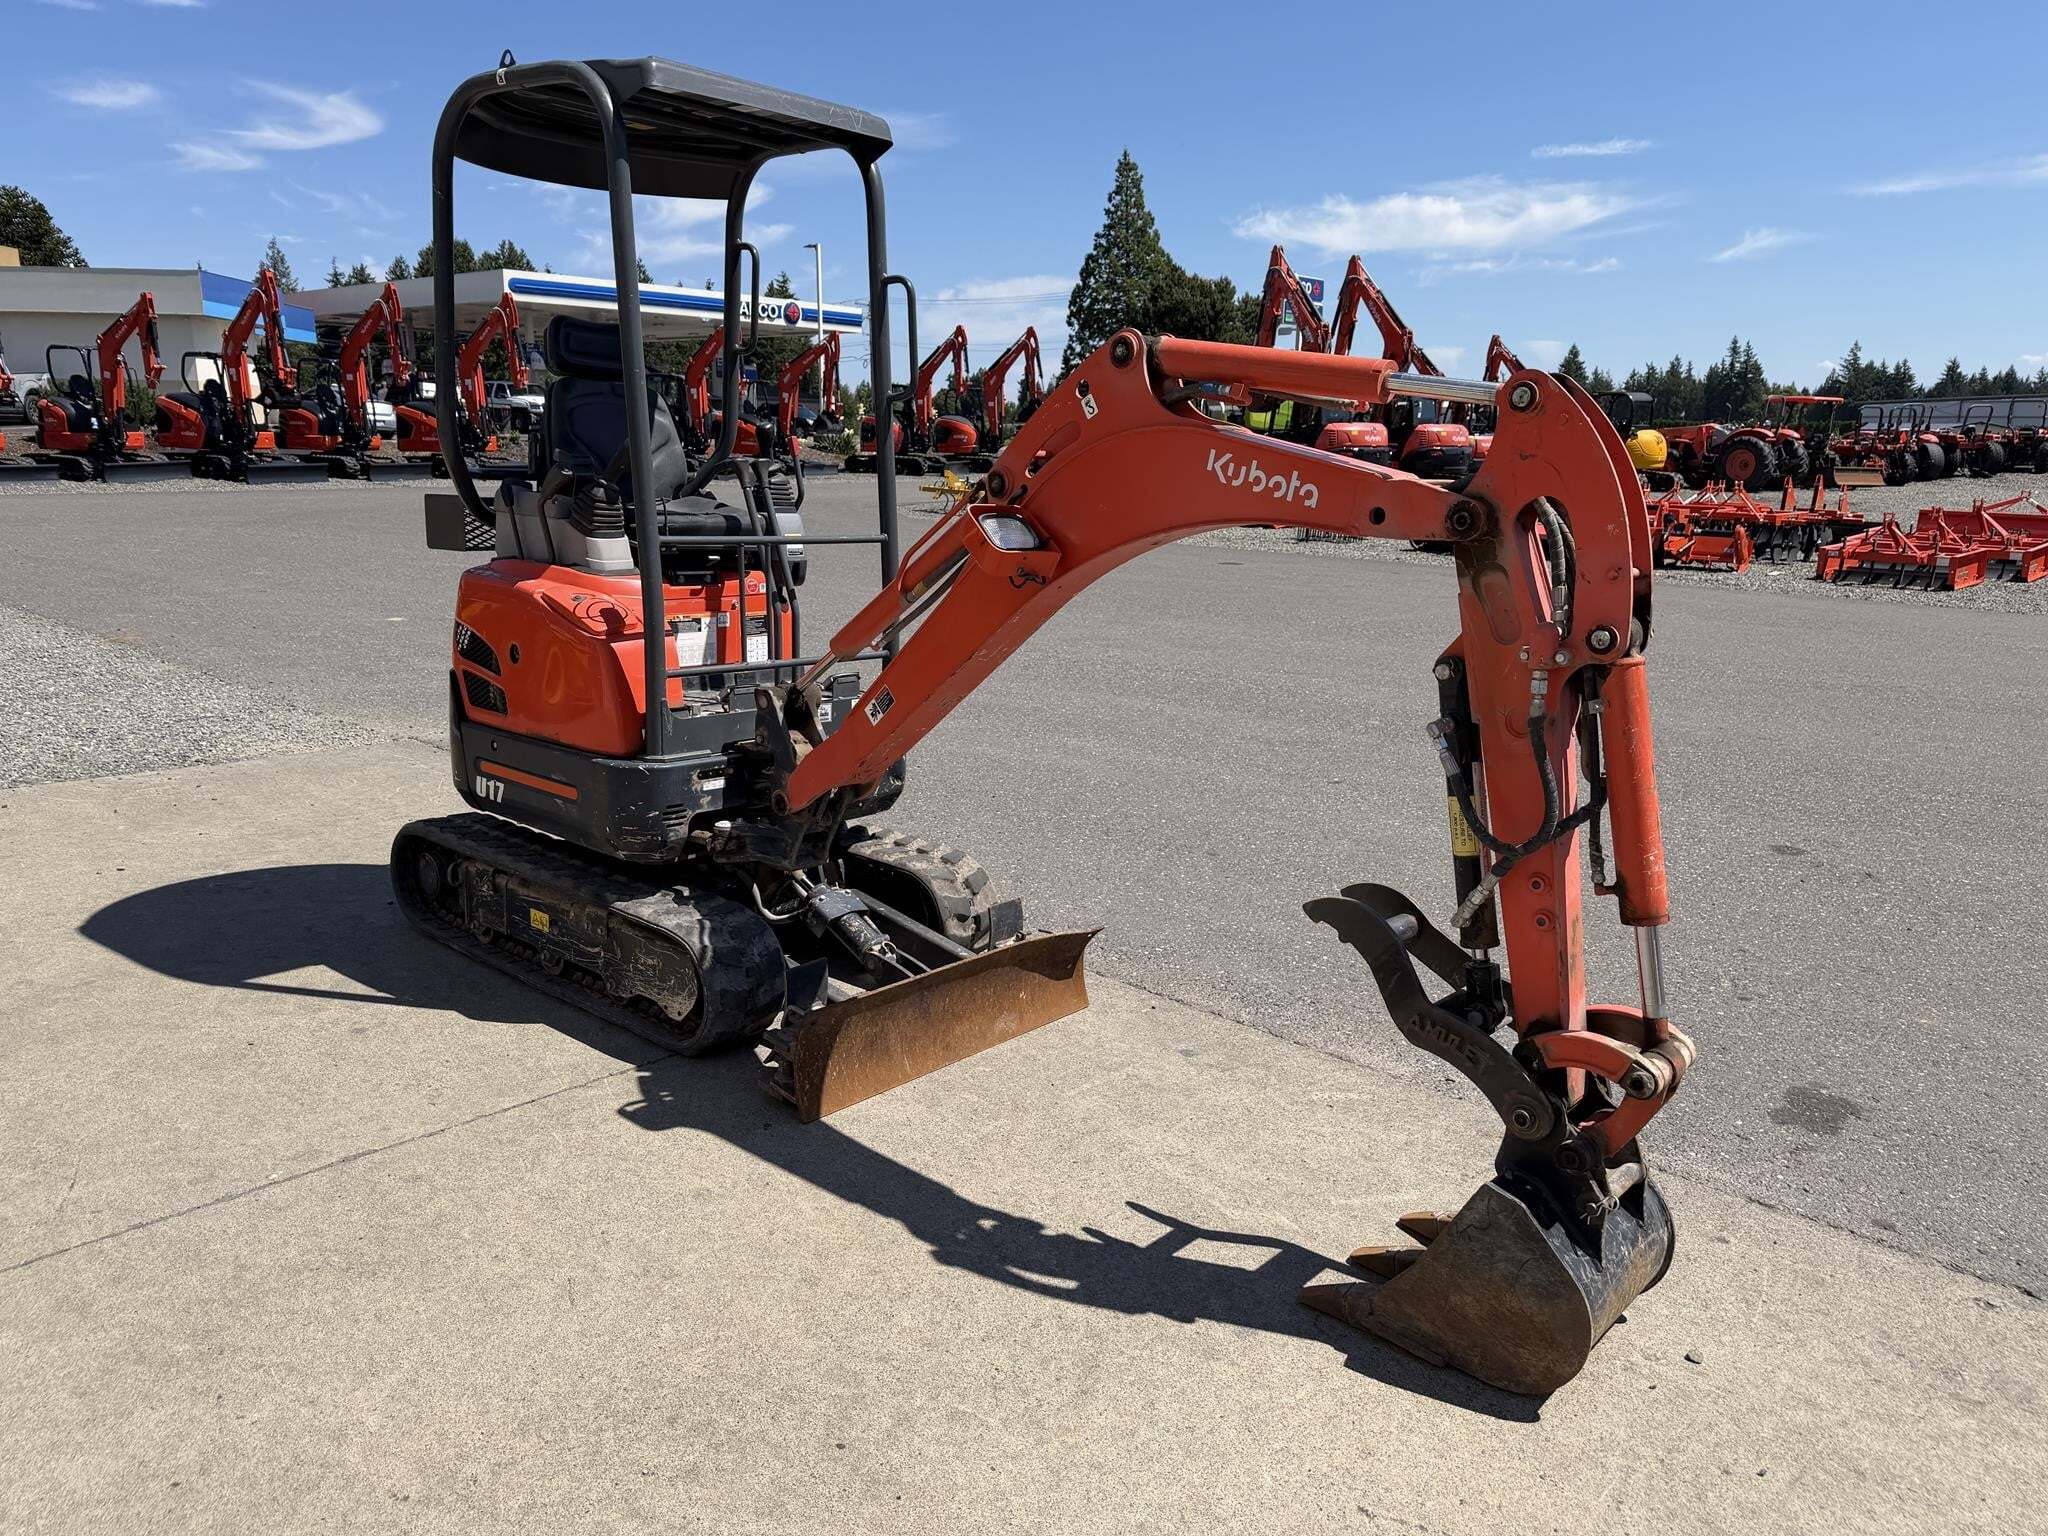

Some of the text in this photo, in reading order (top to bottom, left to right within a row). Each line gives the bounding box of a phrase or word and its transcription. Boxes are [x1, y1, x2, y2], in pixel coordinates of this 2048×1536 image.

[740, 301, 779, 319] ACO
[1206, 448, 1319, 509] Kubota
[476, 775, 505, 803] U17
